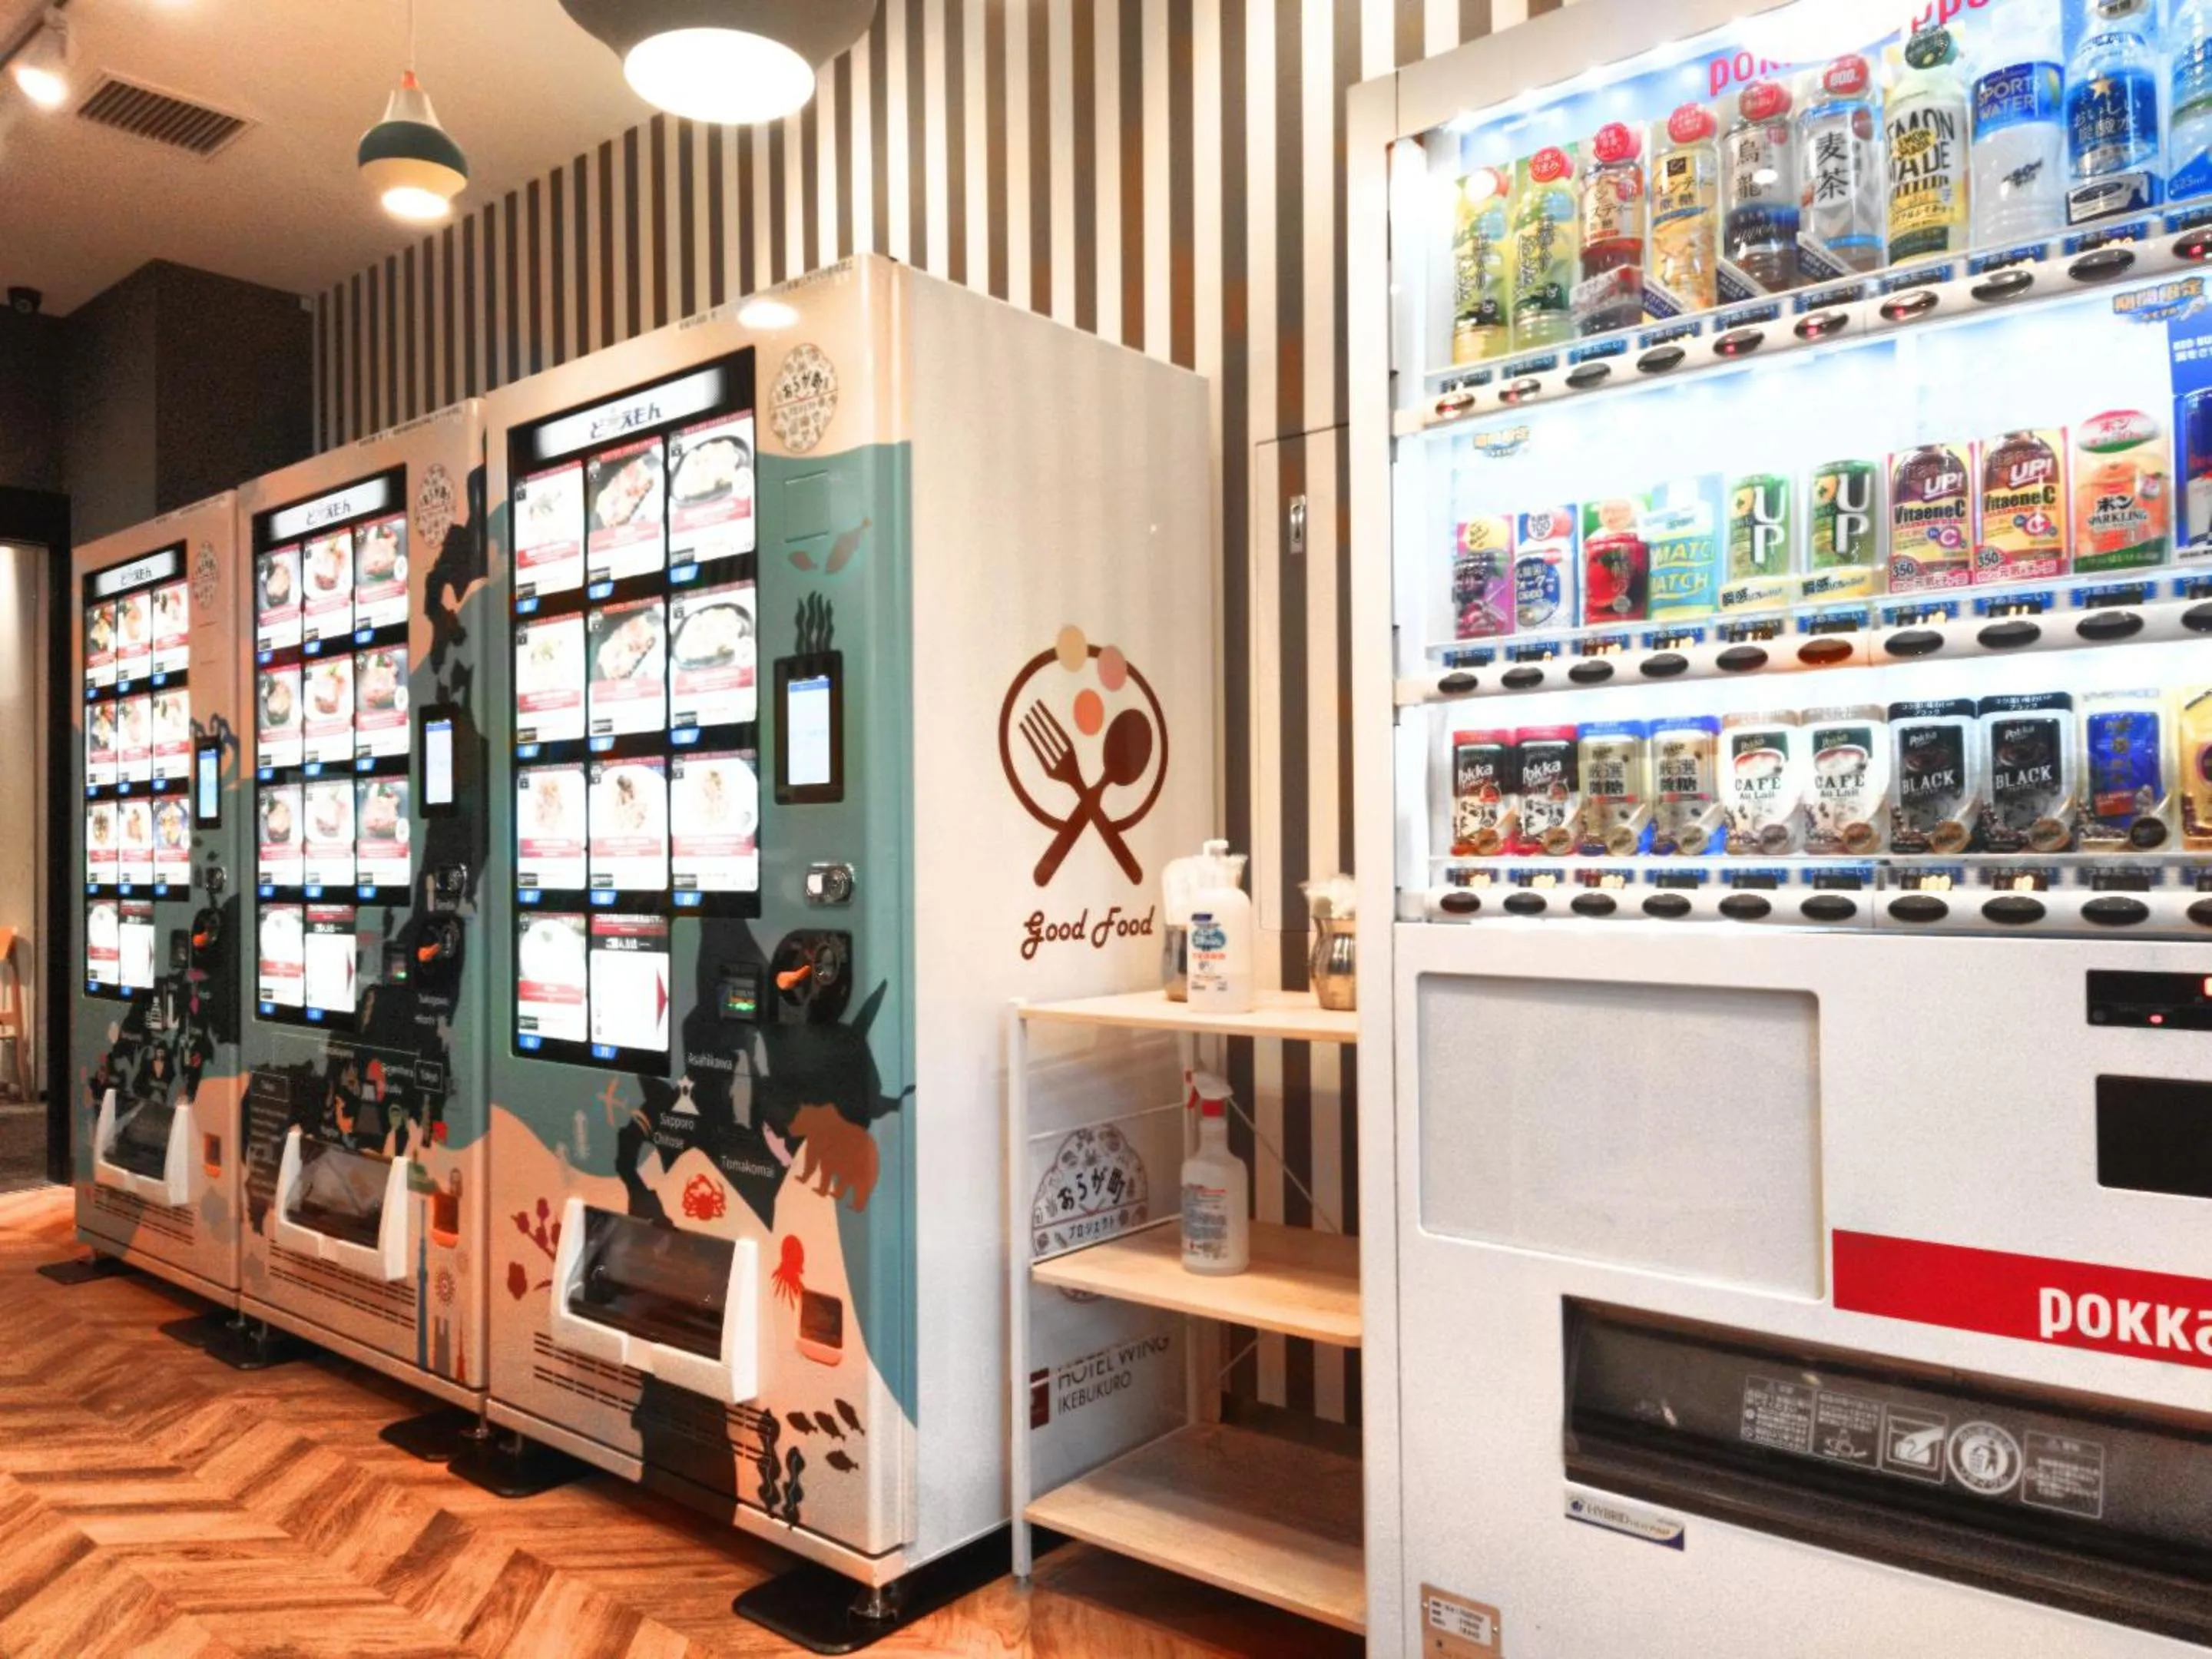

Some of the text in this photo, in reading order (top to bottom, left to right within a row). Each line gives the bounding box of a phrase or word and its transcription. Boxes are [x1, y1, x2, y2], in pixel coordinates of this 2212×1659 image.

[1816, 132, 1849, 202] 麦茶
[2011, 458, 2053, 482] UP!
[1924, 472, 1964, 495] UP!
[1901, 770, 1955, 794] BLACK
[1995, 764, 2053, 790] BLACK
[1022, 905, 1155, 960] Good Food
[660, 1113, 695, 1132] Sapporo
[654, 1132, 685, 1151] Chitose
[720, 1155, 775, 1178] Tomakomai
[1057, 1167, 1125, 1210] おらが町
[1058, 1372, 1132, 1413] IKEBUKURO
